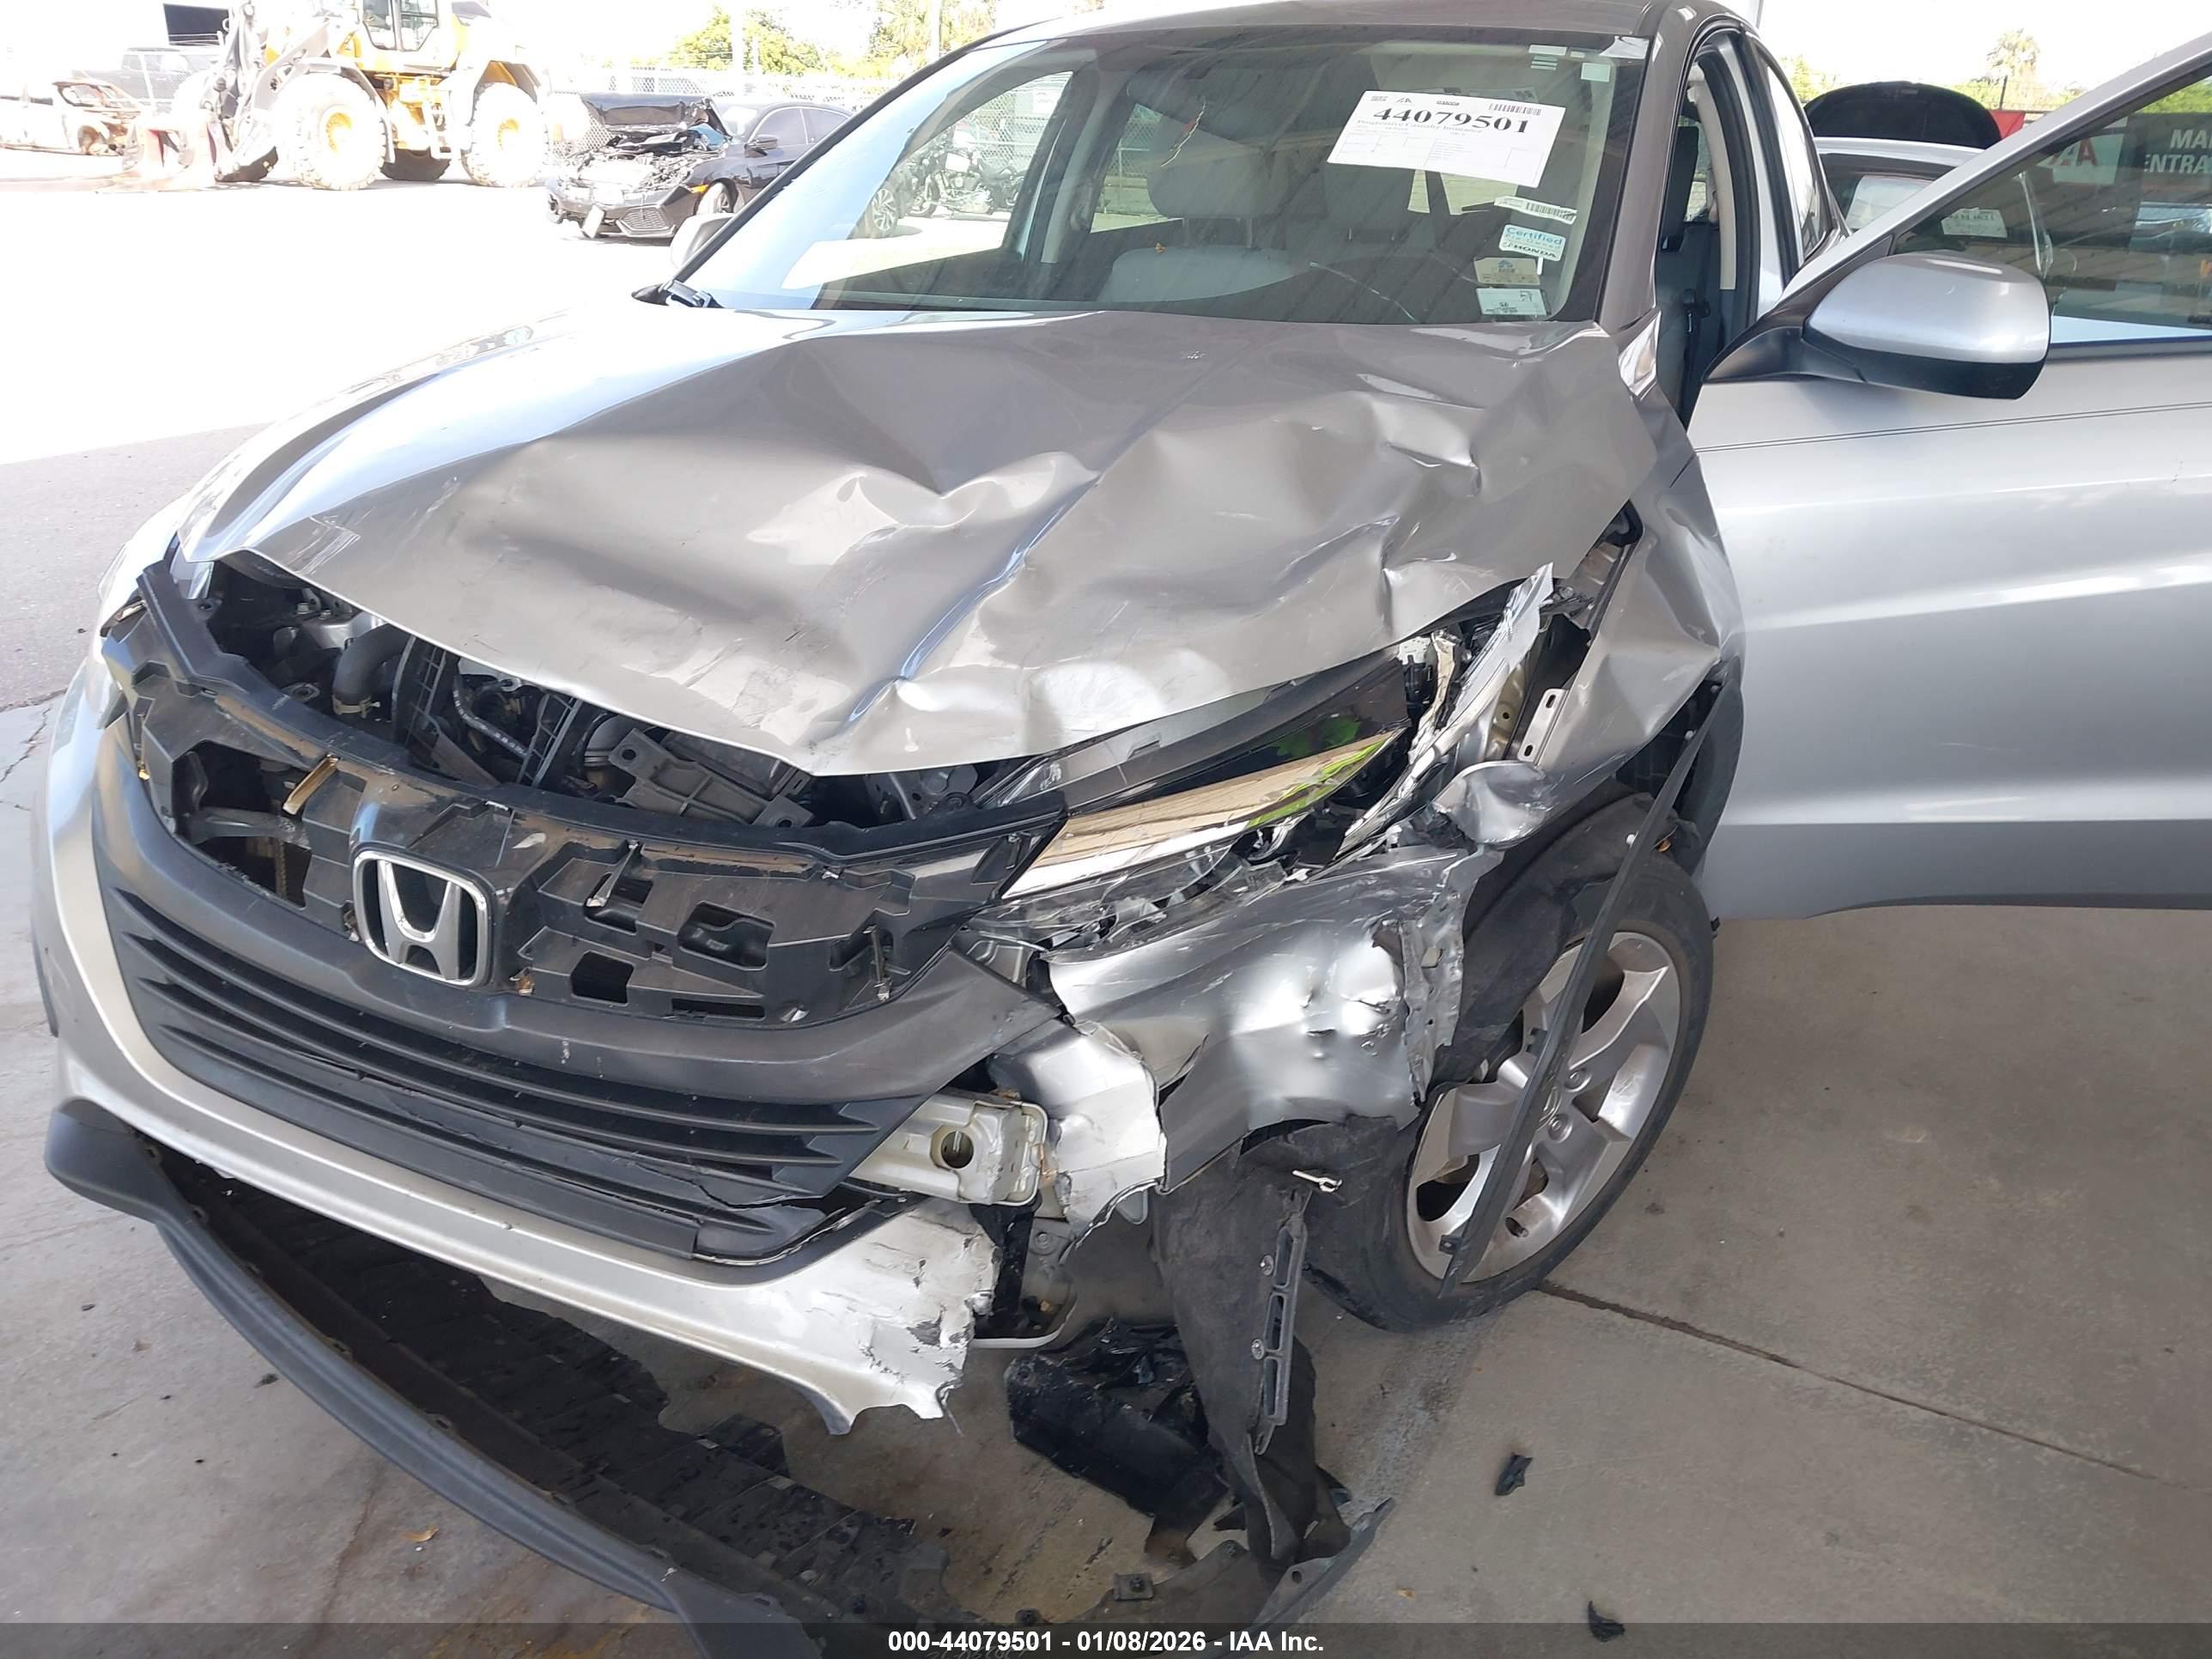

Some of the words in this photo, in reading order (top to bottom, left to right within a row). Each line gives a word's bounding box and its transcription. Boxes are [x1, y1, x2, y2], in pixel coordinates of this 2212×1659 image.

[1373, 108, 1528, 133] 44079501
[2171, 129, 2212, 149] MA
[1506, 227, 1563, 245] Certified
[1514, 244, 1557, 258] HONDA
